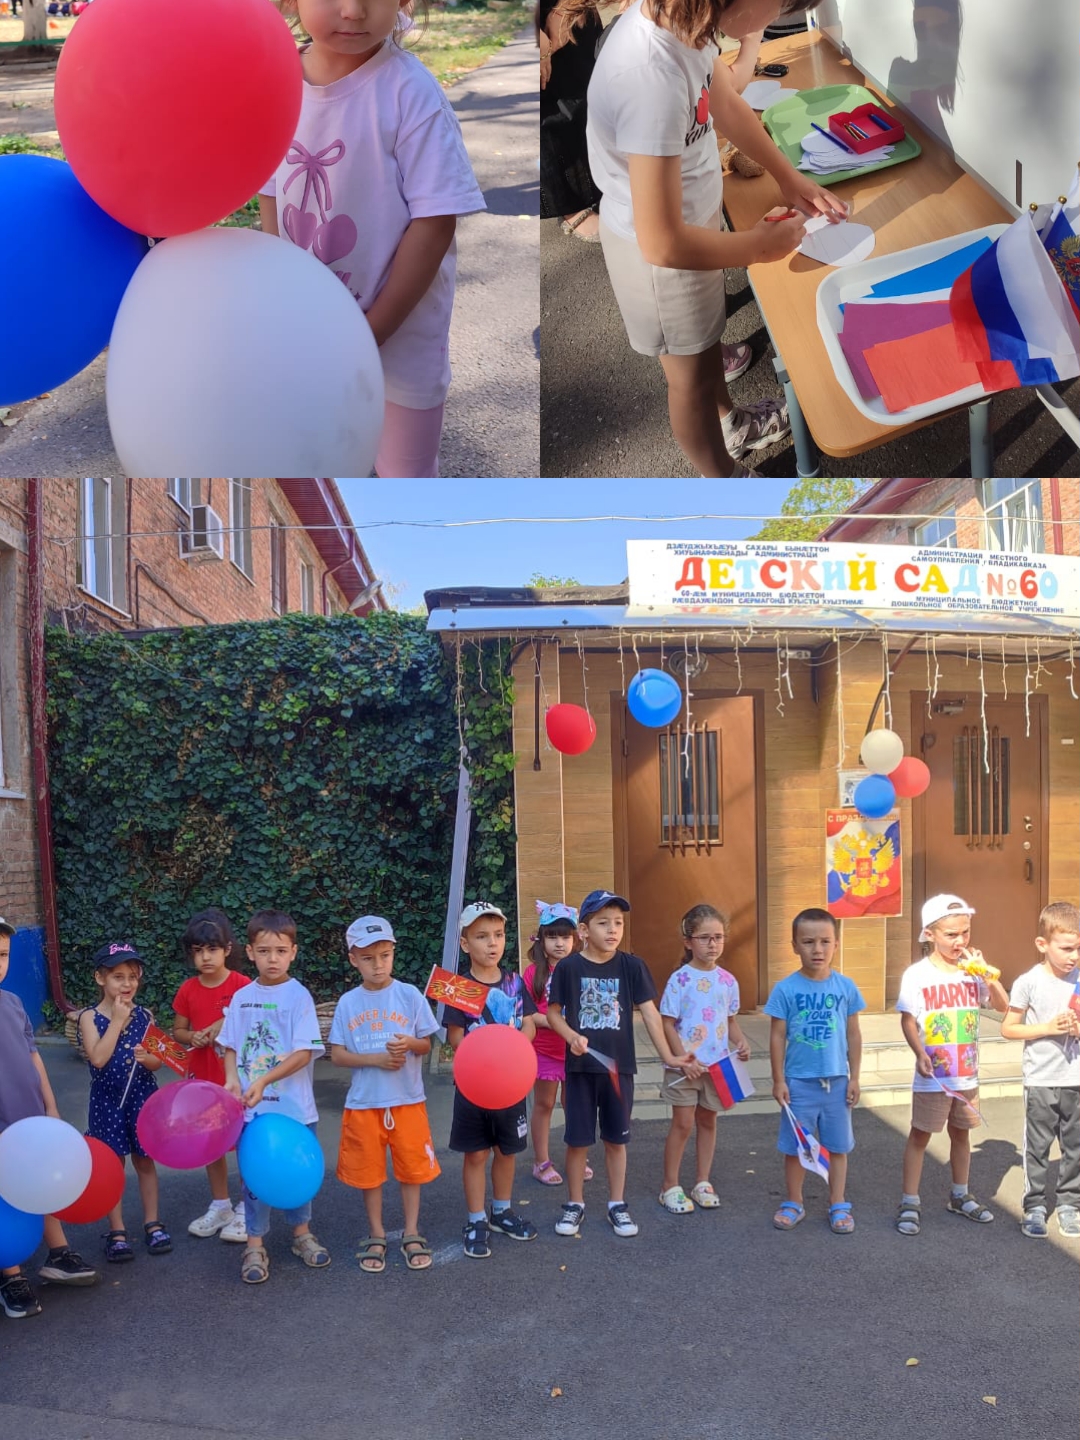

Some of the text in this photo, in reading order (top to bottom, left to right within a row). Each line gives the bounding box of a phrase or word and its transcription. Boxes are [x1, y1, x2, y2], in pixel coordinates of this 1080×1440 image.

[911, 555, 980, 565] САМОУПРАВЛЕНИЯ
[918, 550, 1028, 562] АДМИНИСТРАЦИЯ МЕСТНОГО
[675, 552, 1059, 599] ДЕТСКИЙ САД №60
[891, 600, 1065, 614] ДОШКОЛЬНОЕ ОБРАЗОВАТЕЛЬНОЕ УЧРЕЖДЕНИЕ
[916, 596, 1038, 607] МУНИЦИПАЛЬНОЕ БЮДЖЕТНОЕ
[795, 992, 847, 1011] ENJOY
[347, 1009, 410, 1033] SILVER LAKE
[805, 1010, 835, 1022] YOUR
[803, 1026, 833, 1041] LIFE
